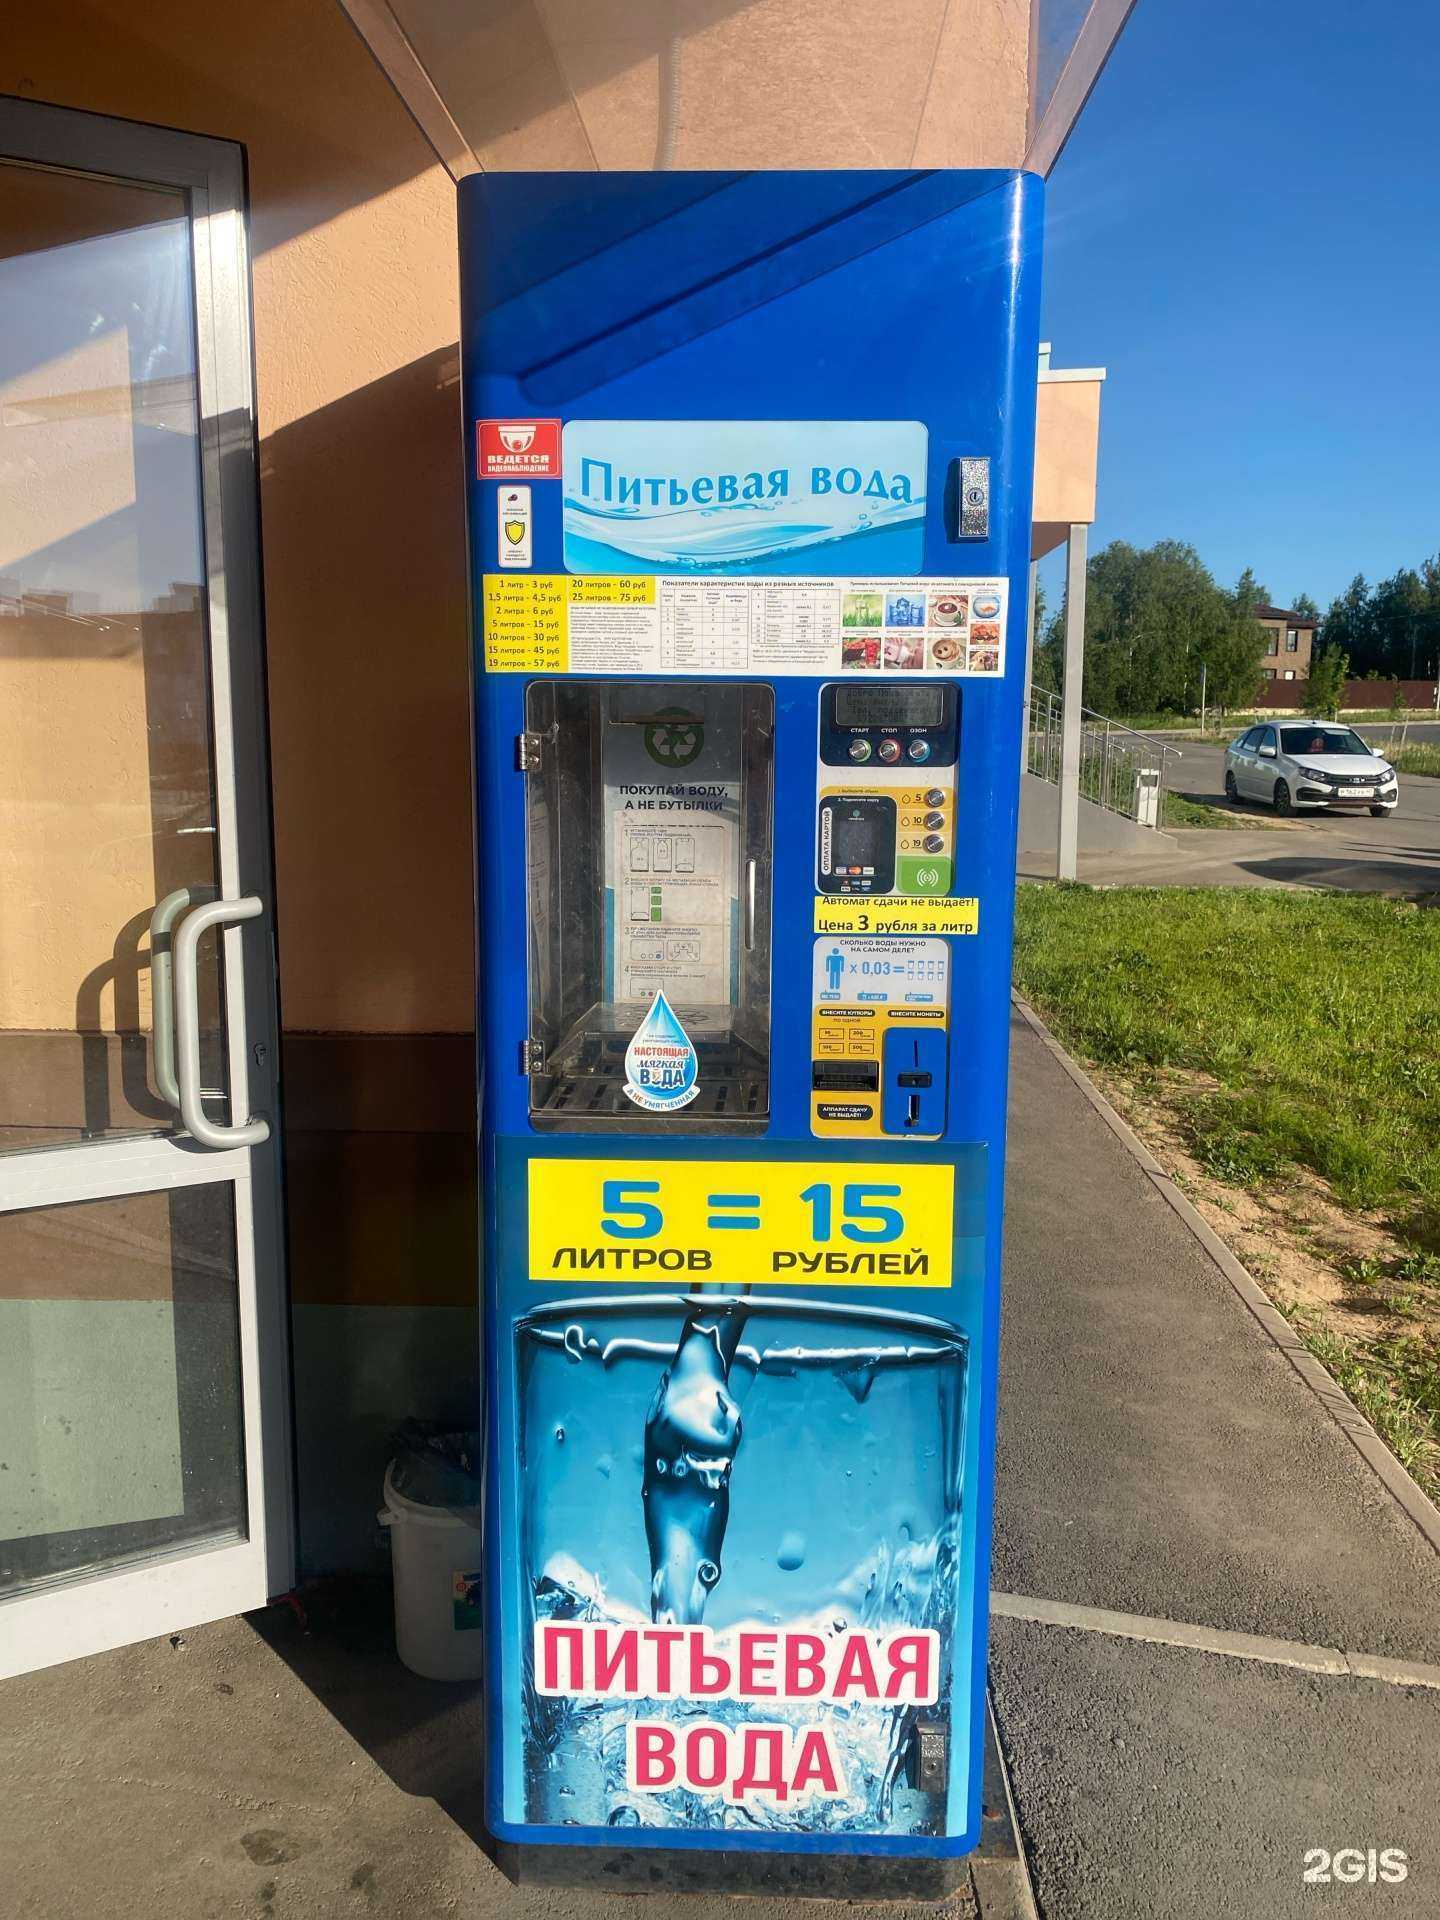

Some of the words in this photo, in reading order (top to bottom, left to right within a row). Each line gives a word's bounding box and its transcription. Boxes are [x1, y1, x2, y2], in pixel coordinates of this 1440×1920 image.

[487, 454, 550, 464] ВЕДЕТСЯ
[580, 457, 788, 506] Питьевая
[811, 466, 913, 504] вода
[500, 580, 504, 588] 1
[532, 580, 538, 588] 3
[572, 580, 583, 588] 20
[620, 580, 630, 588] 60
[632, 581, 646, 589] руб
[632, 594, 646, 602] руб
[540, 608, 554, 616] руб
[534, 620, 544, 628] 15
[488, 633, 498, 641] 10
[534, 633, 544, 641] 30
[546, 634, 560, 642] руб
[489, 646, 498, 654] 15
[534, 646, 544, 654] 45
[546, 647, 560, 655] руб
[534, 659, 544, 667] 57
[546, 660, 560, 668] руб
[620, 784, 686, 795] ПОКУПАЙ
[688, 786, 728, 798] ВОДУ,
[916, 794, 922, 802] 5
[624, 801, 634, 810] А
[638, 801, 654, 810] НЕ
[658, 801, 723, 810] БУТЫЛКИ
[913, 816, 922, 824] 10
[822, 810, 830, 841] КАРТОЙ
[822, 896, 870, 906] Автомат
[874, 898, 908, 907] сдачи
[911, 898, 924, 906] не
[818, 920, 854, 932] Цена
[858, 915, 869, 931] 3
[876, 920, 918, 933] рубля
[922, 922, 936, 932] за
[940, 922, 973, 934] литр
[634, 1046, 689, 1058] НАСТОЯЩАЯ
[632, 1093, 642, 1102] НЕ
[644, 1091, 695, 1109] УМЯГЧЕННАЯ
[600, 1180, 664, 1239] 5
[707, 1194, 760, 1229] =
[799, 1183, 905, 1243] 15
[552, 1247, 712, 1271] ЛИТРОВ
[773, 1248, 929, 1275] РУБЛЕЙ
[544, 1627, 930, 1699] ПИТЬЕВАЯ
[635, 1726, 839, 1800] ВОДА
